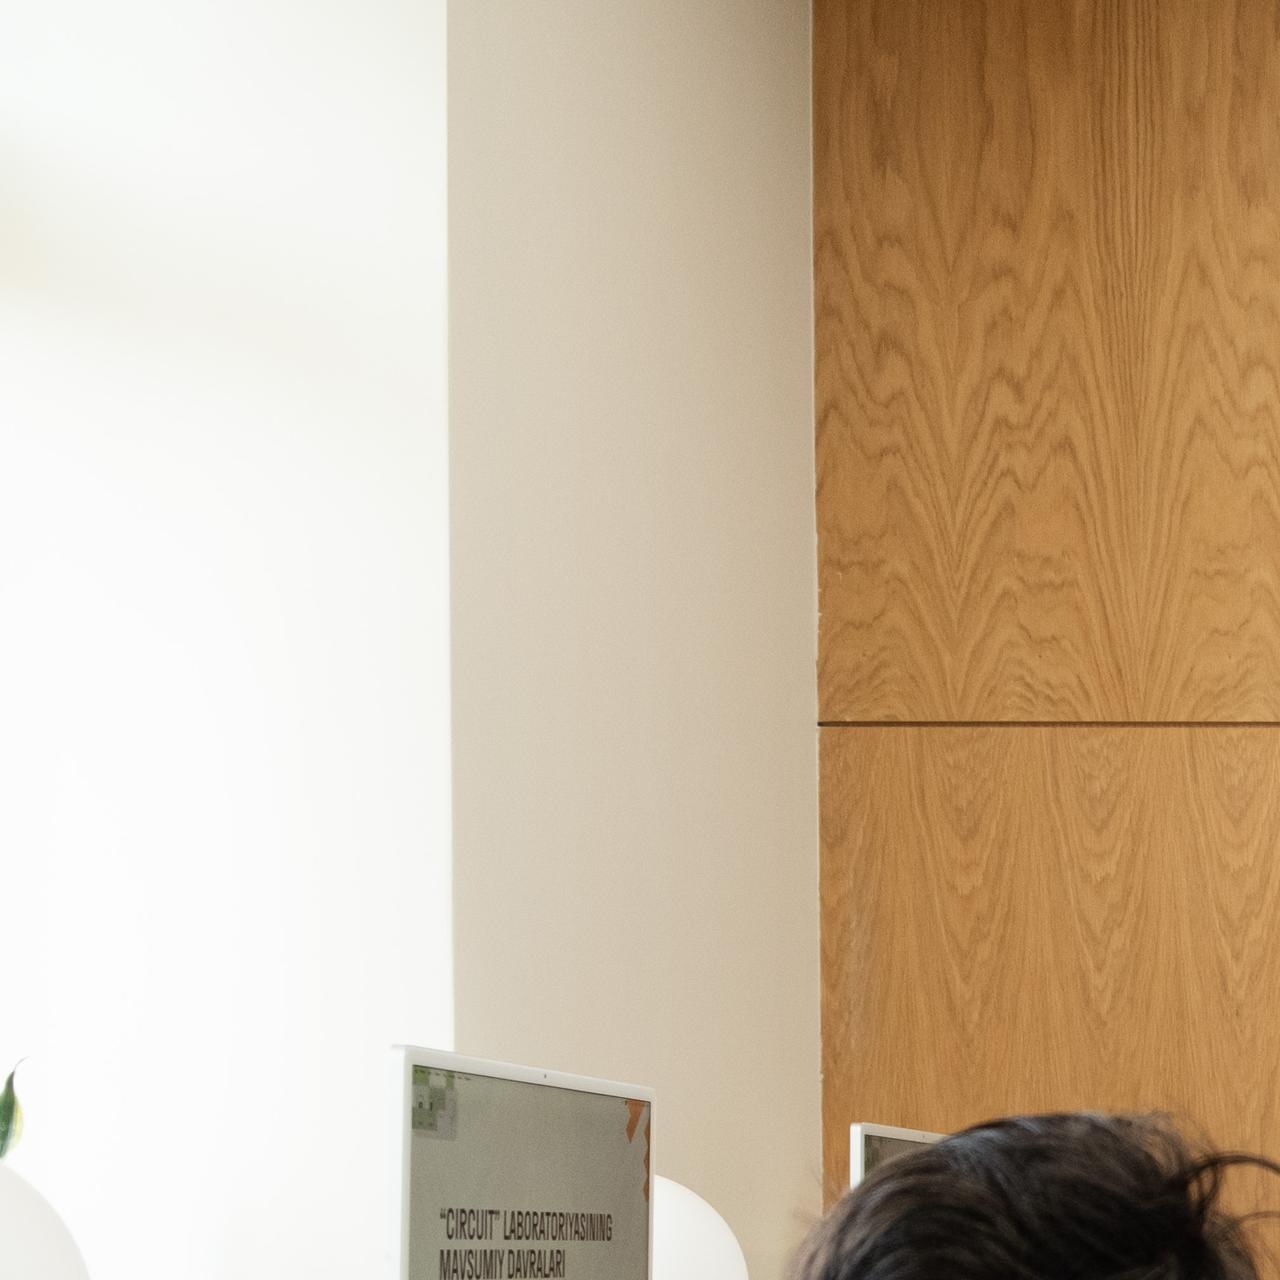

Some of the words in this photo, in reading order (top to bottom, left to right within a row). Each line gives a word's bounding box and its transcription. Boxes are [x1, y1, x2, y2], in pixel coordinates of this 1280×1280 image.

[503, 1209, 613, 1242] LABORATORIYASINING
[439, 1248, 505, 1280] MAVSUMIY
[507, 1248, 566, 1279] DAVRALARI
